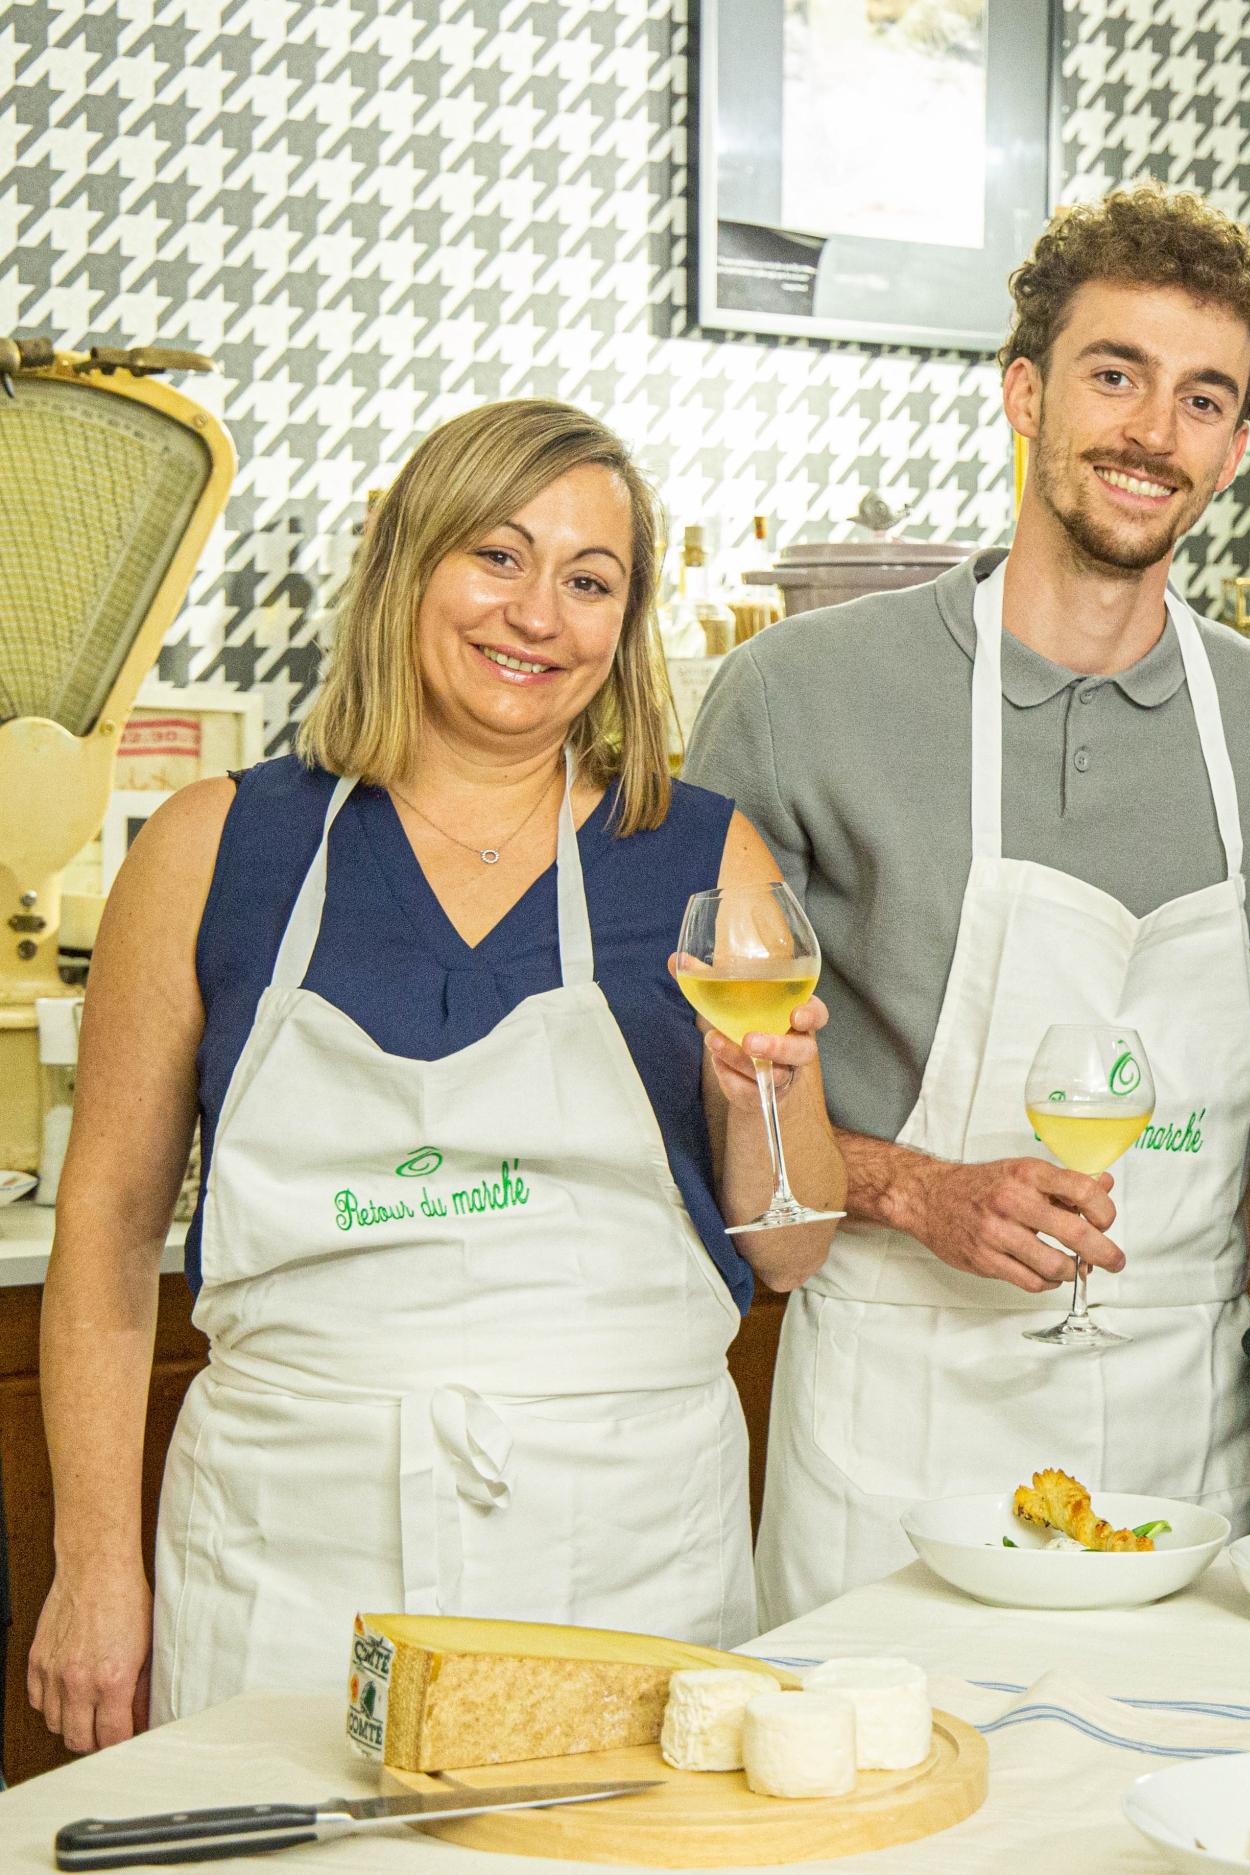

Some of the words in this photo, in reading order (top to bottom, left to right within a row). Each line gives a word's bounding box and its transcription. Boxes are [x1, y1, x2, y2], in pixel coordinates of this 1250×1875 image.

[334, 1187, 415, 1232] Retour
[420, 1186, 448, 1218] du
[452, 1157, 531, 1216] marché
